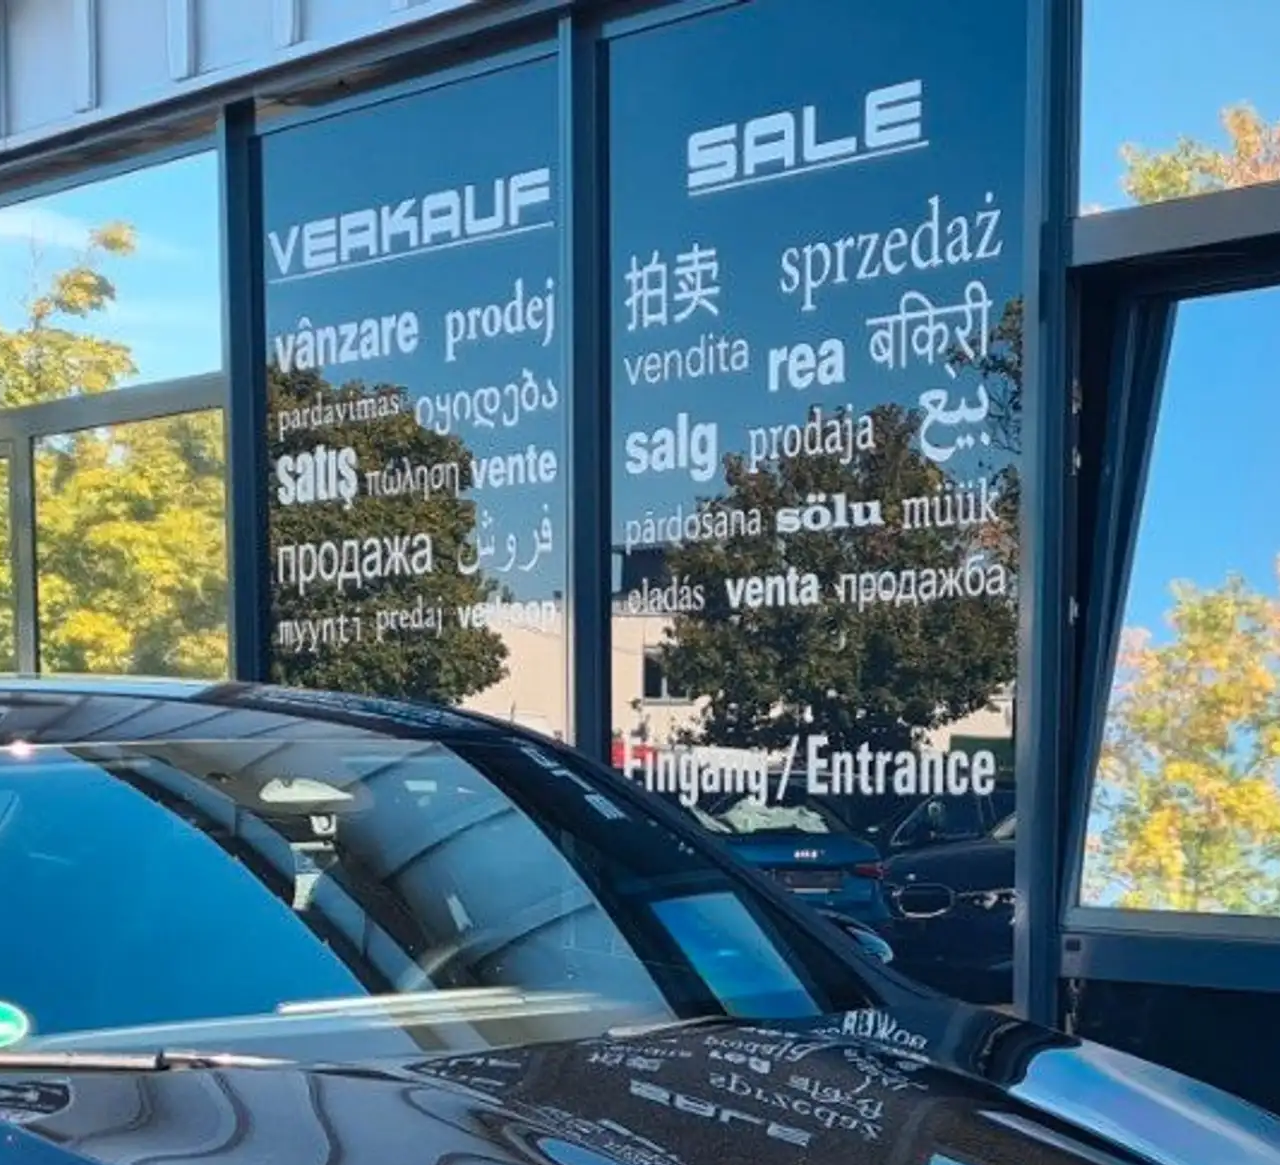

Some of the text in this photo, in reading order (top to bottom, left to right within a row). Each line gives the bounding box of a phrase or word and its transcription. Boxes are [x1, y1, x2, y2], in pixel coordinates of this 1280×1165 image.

[688, 79, 922, 188] SALE
[268, 168, 550, 275] VERKAUF
[779, 191, 1003, 311] sprzedaż
[624, 242, 720, 332] 拍卖
[276, 277, 555, 374] vânzare prodej
[623, 333, 846, 392] vendita rea
[470, 444, 558, 489] vente
[625, 403, 876, 482] salg prodaja
[276, 444, 358, 510] satış
[365, 457, 459, 500] πώληση
[626, 497, 762, 556] pārdošana
[776, 490, 886, 532] sölu
[277, 533, 433, 595] продажа
[627, 566, 818, 614] eladás venta
[838, 554, 1008, 611] продажба
[278, 607, 361, 652] myynti
[376, 595, 443, 643] predaj
